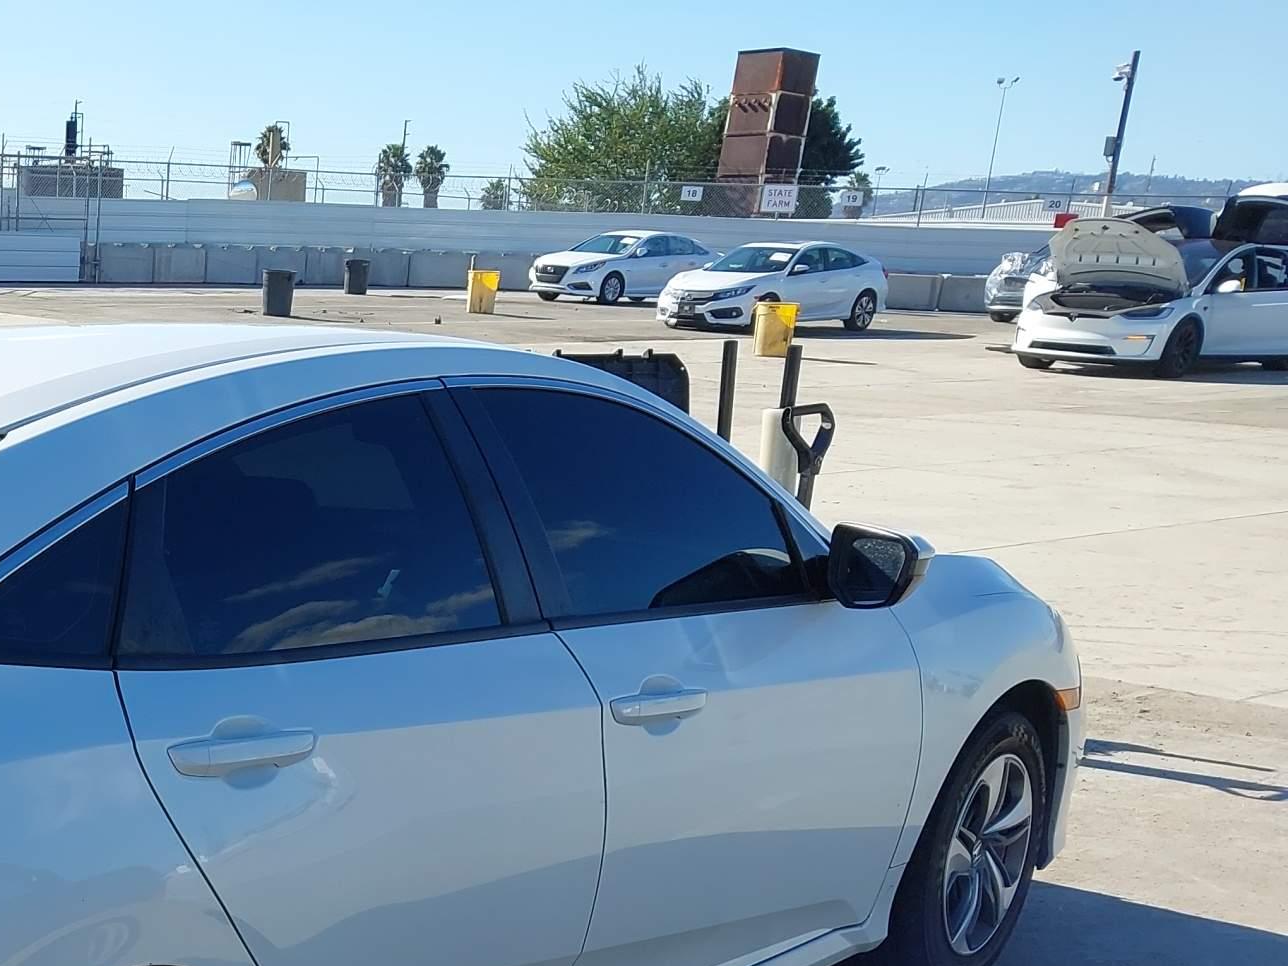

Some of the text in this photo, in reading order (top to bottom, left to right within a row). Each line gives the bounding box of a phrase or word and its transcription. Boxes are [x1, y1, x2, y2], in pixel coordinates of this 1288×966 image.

[686, 189, 697, 198] 18
[767, 188, 793, 197] STATE
[766, 199, 790, 208] FARM
[846, 195, 858, 203] 19
[1048, 200, 1062, 209] 20
